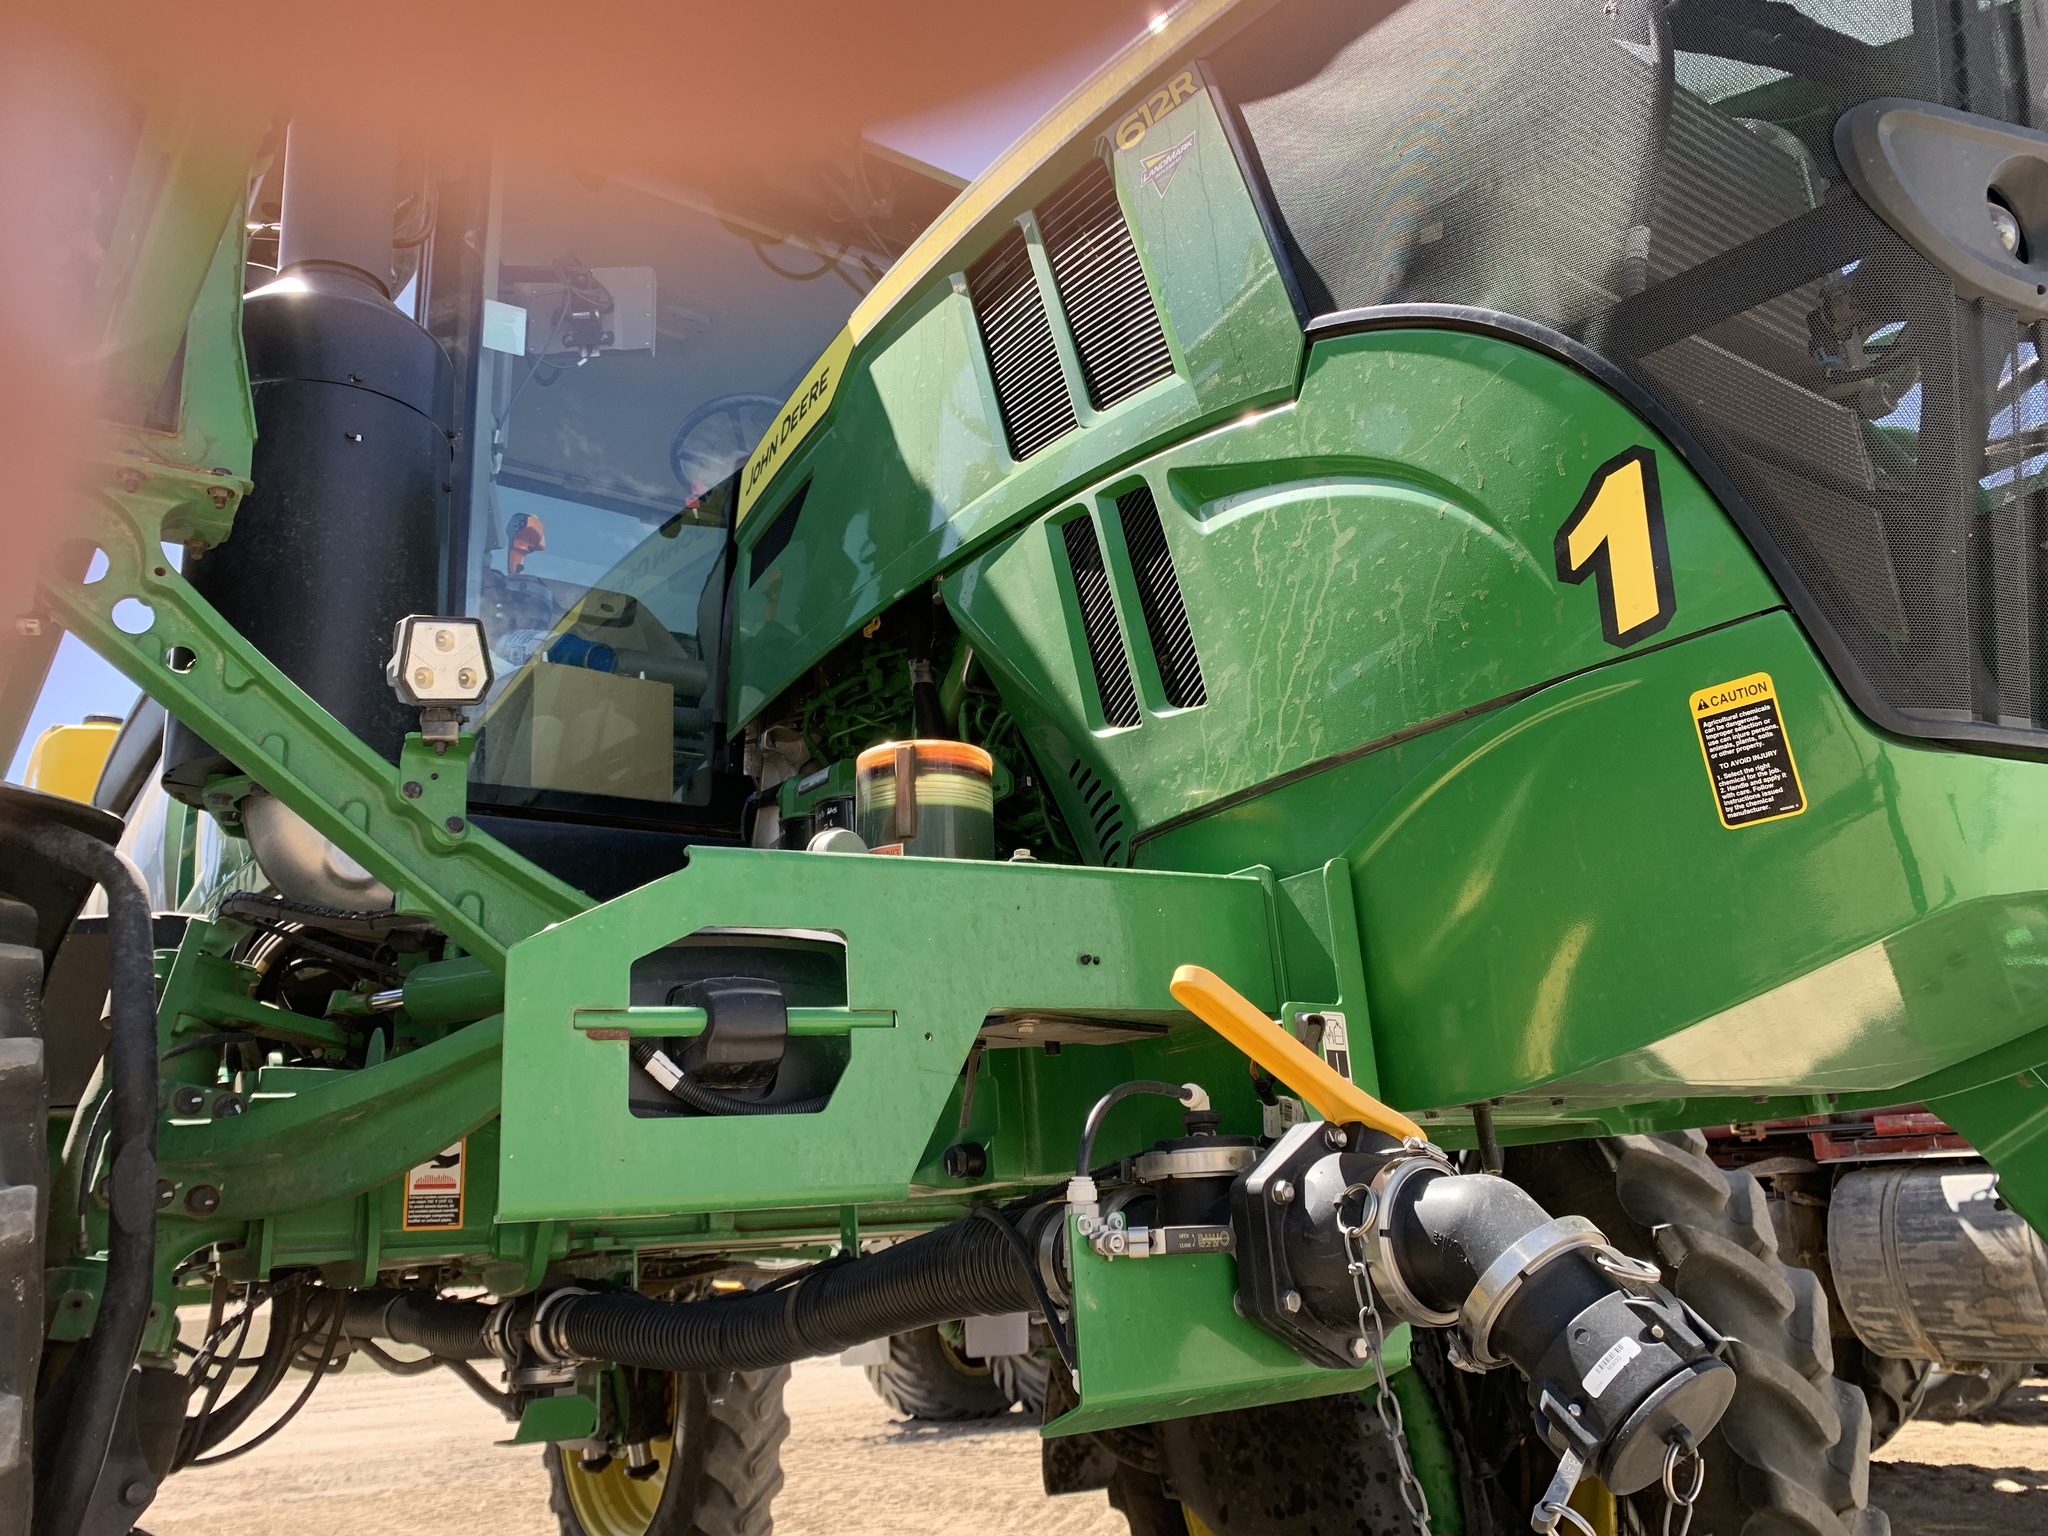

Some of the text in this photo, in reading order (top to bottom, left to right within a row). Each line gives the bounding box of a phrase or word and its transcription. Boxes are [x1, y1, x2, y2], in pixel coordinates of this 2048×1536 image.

[1115, 71, 1199, 150] 612R
[1143, 138, 1194, 182] LANDMARK
[746, 366, 830, 496] JOHN DEERE
[1558, 447, 1674, 647] 1
[1710, 681, 1768, 706] CAUTION
[1703, 705, 1770, 727] Agricultural chemicals
[1726, 716, 1760, 728] dangerous.
[1706, 729, 1733, 740] Improper
[1734, 721, 1762, 732] selection
[1732, 731, 1750, 740] injure
[1736, 737, 1757, 747] plants,
[1736, 742, 1764, 753] property.
[1731, 757, 1751, 767] AVOID
[1752, 750, 1777, 761] INJURY
[1723, 770, 1743, 779] Select
[1755, 763, 1770, 772] right
[1719, 776, 1746, 787] chemical
[1727, 782, 1749, 791] Handle
[1763, 775, 1780, 783] apply
[1752, 783, 1774, 792] Follow
[1724, 787, 1783, 806] instructions issued
[1746, 796, 1774, 807] chemical
[1727, 805, 1770, 818] manufacturer.
